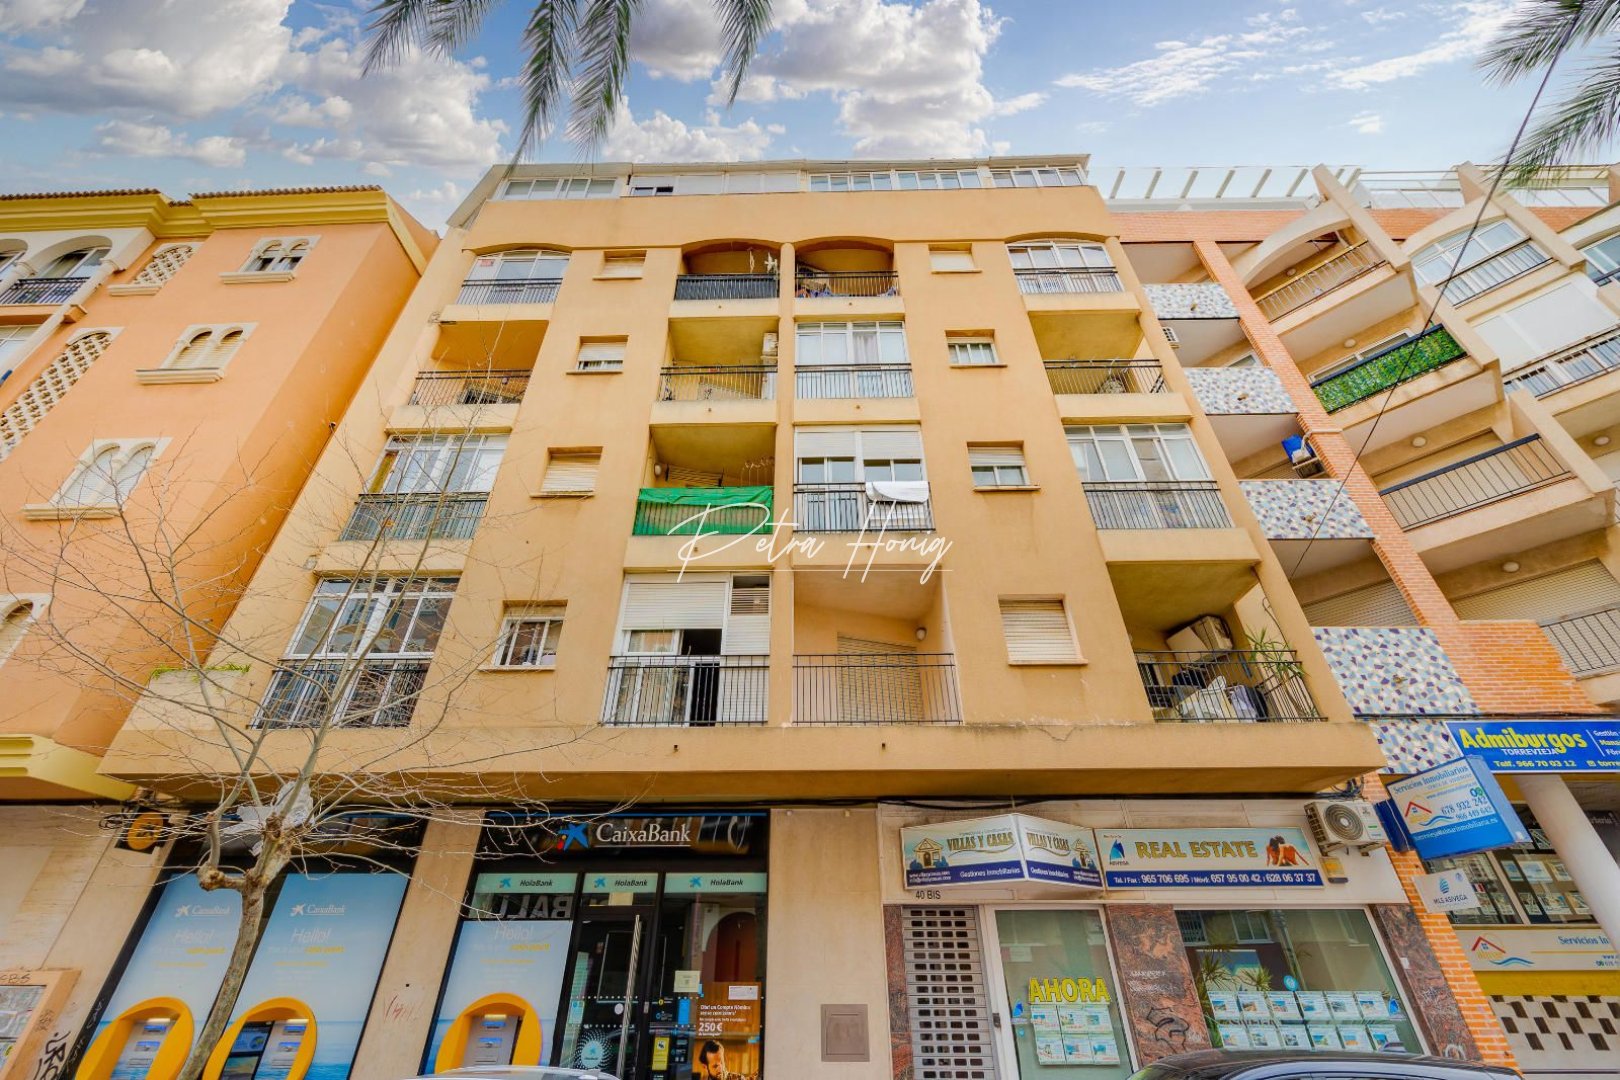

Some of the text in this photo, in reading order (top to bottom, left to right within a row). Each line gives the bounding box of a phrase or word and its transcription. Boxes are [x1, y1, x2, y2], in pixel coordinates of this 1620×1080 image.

[1459, 727, 1588, 754] Admiburgos
[1501, 748, 1559, 756] TORREVIEJA
[1393, 780, 1423, 794] Servicios
[1422, 765, 1468, 784] Inmobiliarios
[596, 822, 691, 843] CaixaBank
[946, 832, 1014, 851] VILLAS Y CASAS
[1026, 833, 1047, 848] VILLAS
[1135, 840, 1258, 859] REAL ESTATE
[519, 879, 553, 887] HolaBank
[614, 879, 648, 887] HolaBank
[710, 878, 744, 887] HolaBank
[1141, 874, 1157, 883] 965
[1157, 874, 1173, 883] 706
[1174, 874, 1190, 883] 695
[1226, 873, 1238, 883] 95
[1239, 873, 1249, 883] 00
[1282, 873, 1293, 883] 06
[1295, 873, 1304, 883] 37
[1306, 873, 1316, 883] 37
[915, 890, 941, 900] 40 BIS
[1557, 935, 1599, 945] Servicios
[1028, 977, 1111, 1003] AHORA
